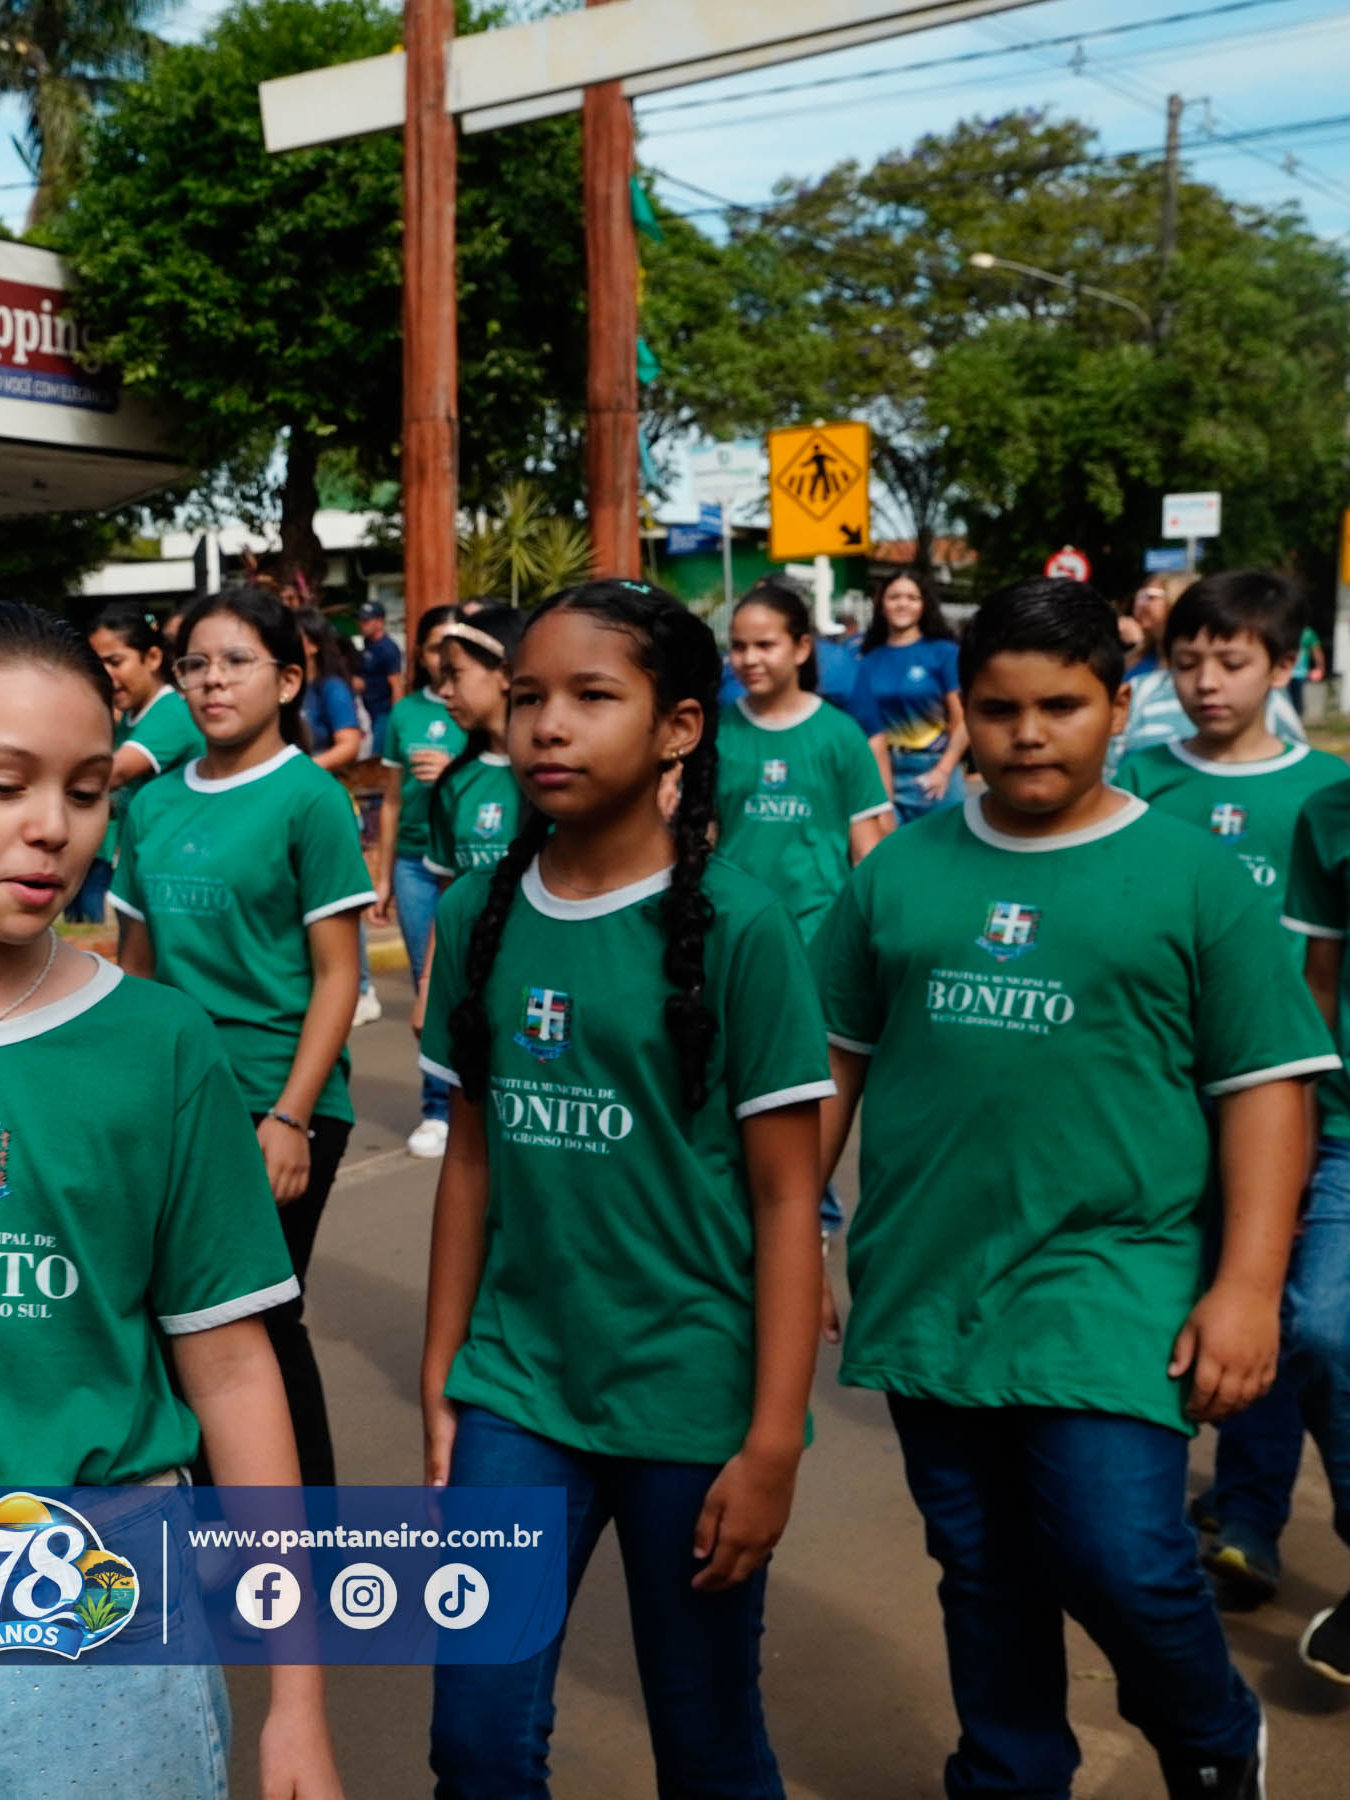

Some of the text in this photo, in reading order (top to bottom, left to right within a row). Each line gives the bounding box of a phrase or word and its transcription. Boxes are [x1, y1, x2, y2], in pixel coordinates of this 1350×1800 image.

[925, 980, 1075, 1025] BONITO
[597, 1088, 617, 1100] DE
[564, 1138, 582, 1151] DO
[584, 1142, 611, 1155] SUL
[34, 1233, 57, 1249] DE
[17, 1303, 52, 1319] SUL
